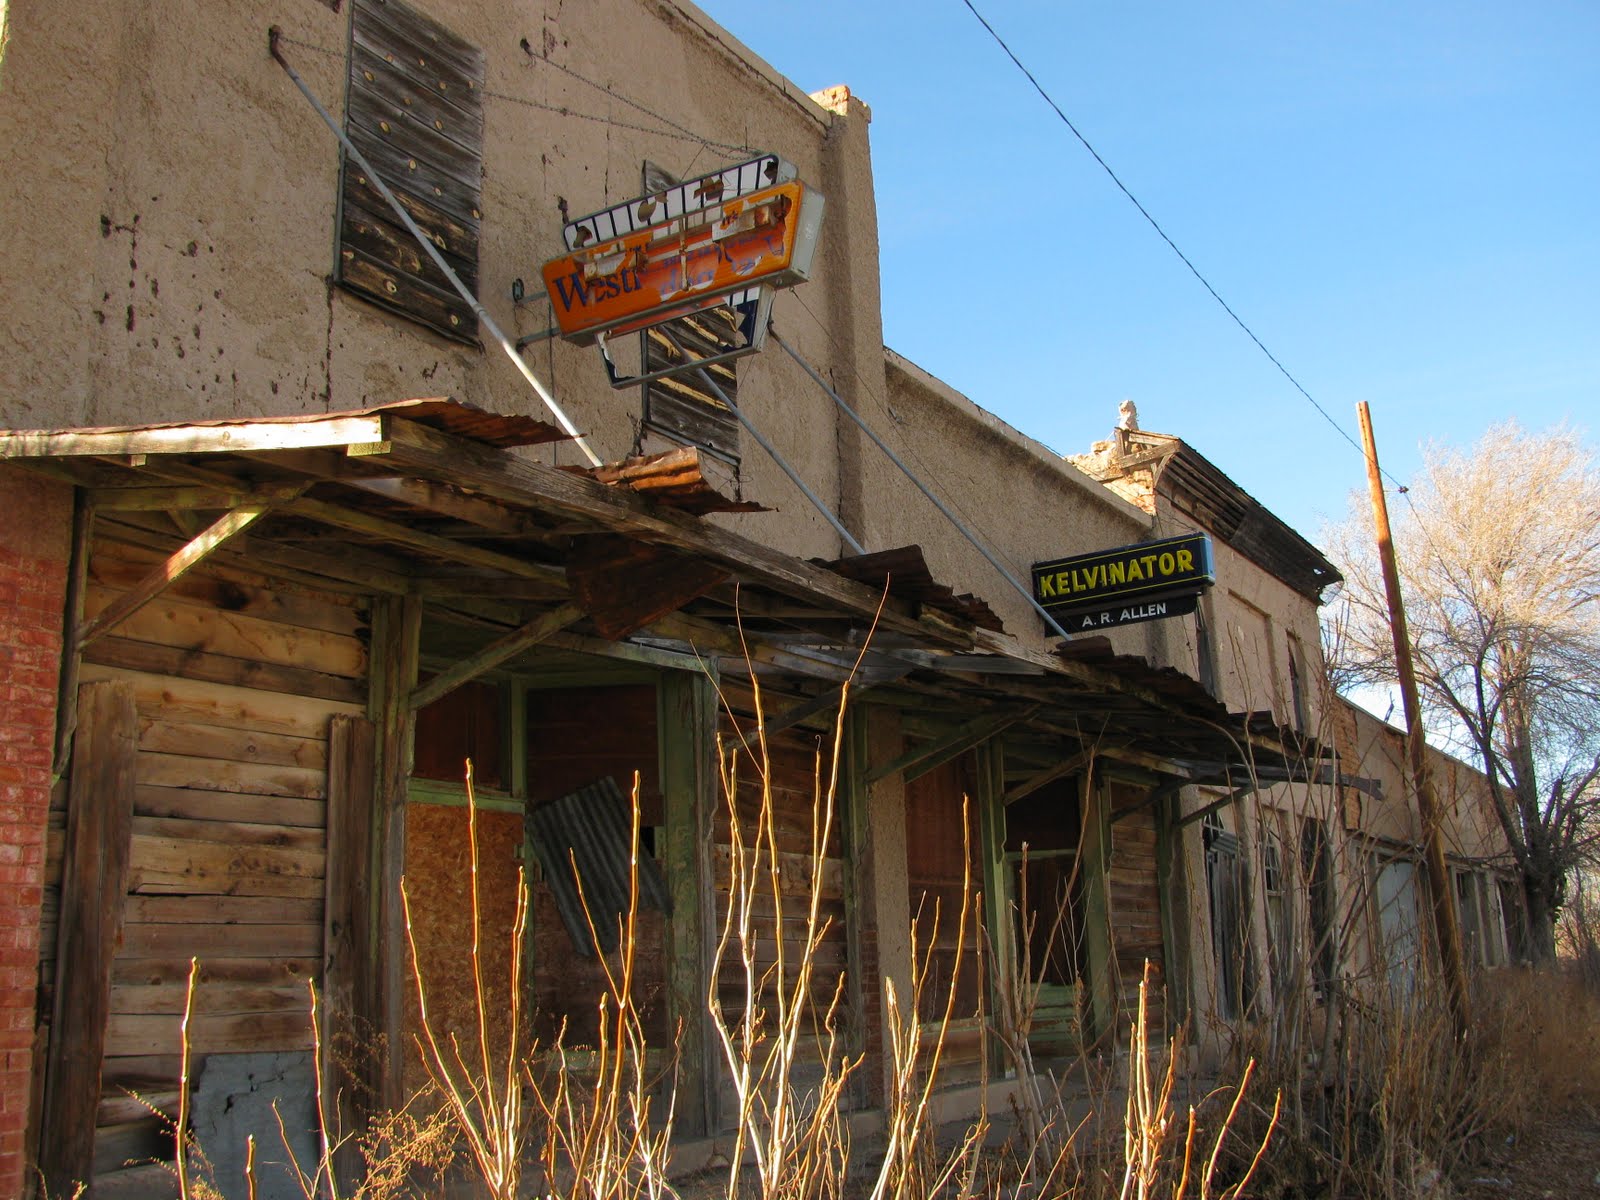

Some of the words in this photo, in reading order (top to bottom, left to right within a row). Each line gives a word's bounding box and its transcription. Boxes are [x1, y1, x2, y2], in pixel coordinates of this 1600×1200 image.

[1039, 549, 1195, 598] KELVINATOR
[1081, 615, 1097, 627] A.
[1100, 612, 1114, 624] R.
[1119, 602, 1167, 621] ALLEN
